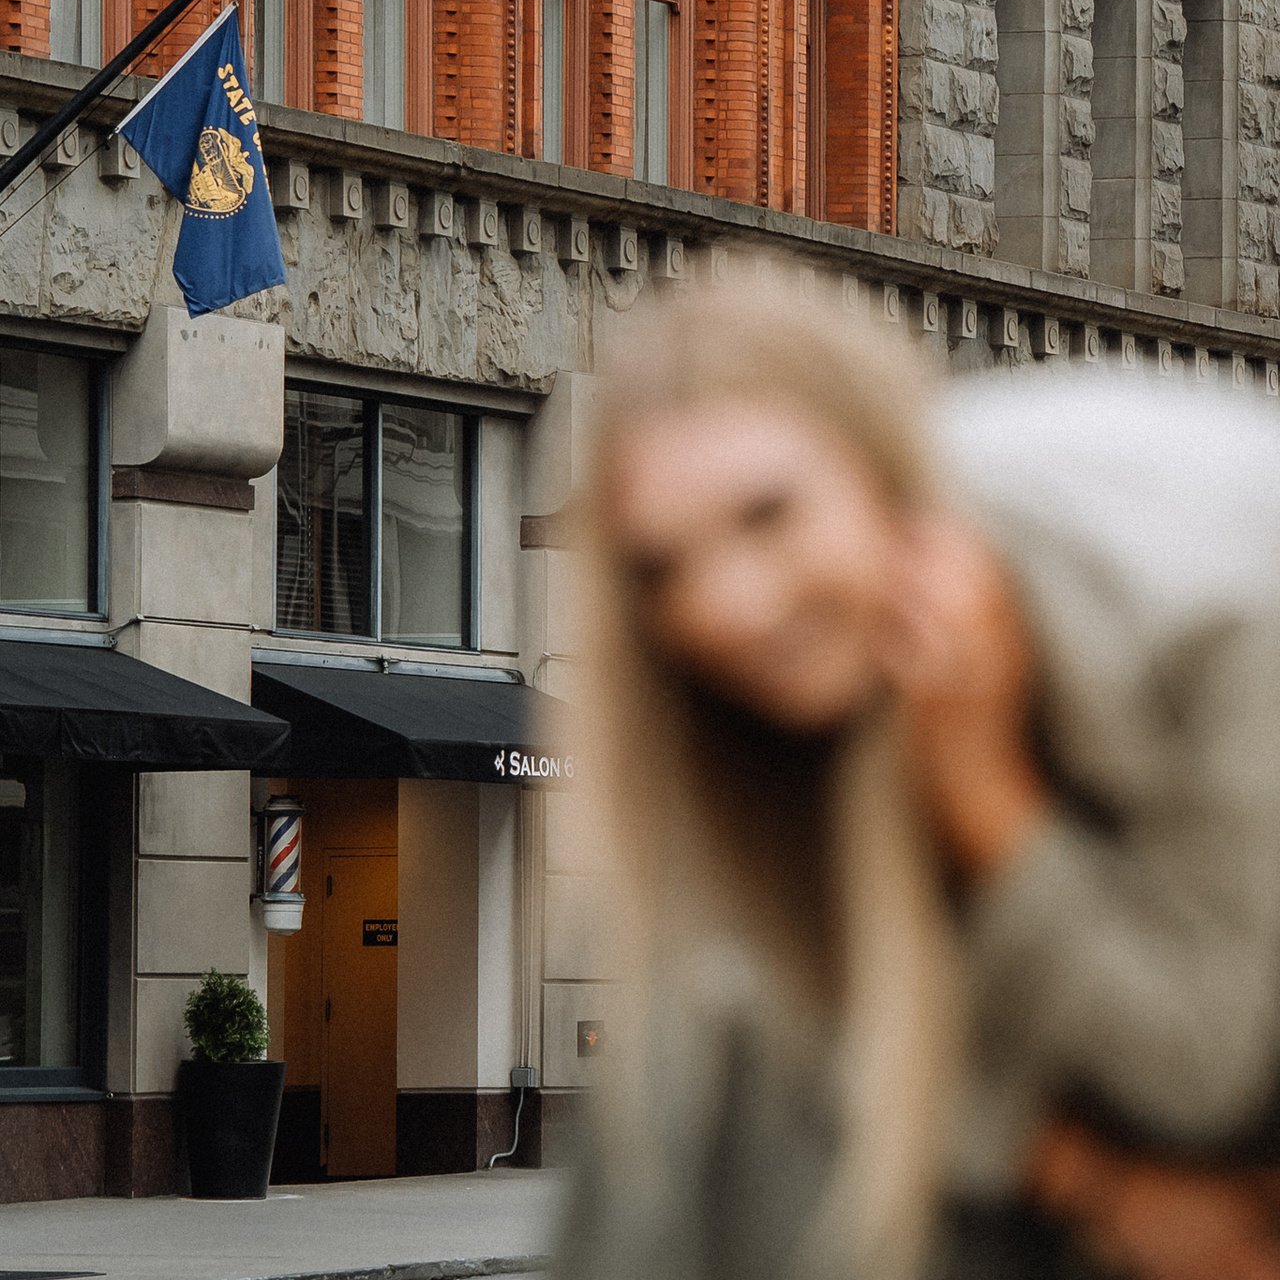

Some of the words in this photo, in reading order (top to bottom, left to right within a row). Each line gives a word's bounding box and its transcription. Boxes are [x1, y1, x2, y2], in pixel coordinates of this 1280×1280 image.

[217, 63, 257, 126] STATE
[509, 751, 560, 777] SALON
[365, 923, 398, 931] EMPLOYE
